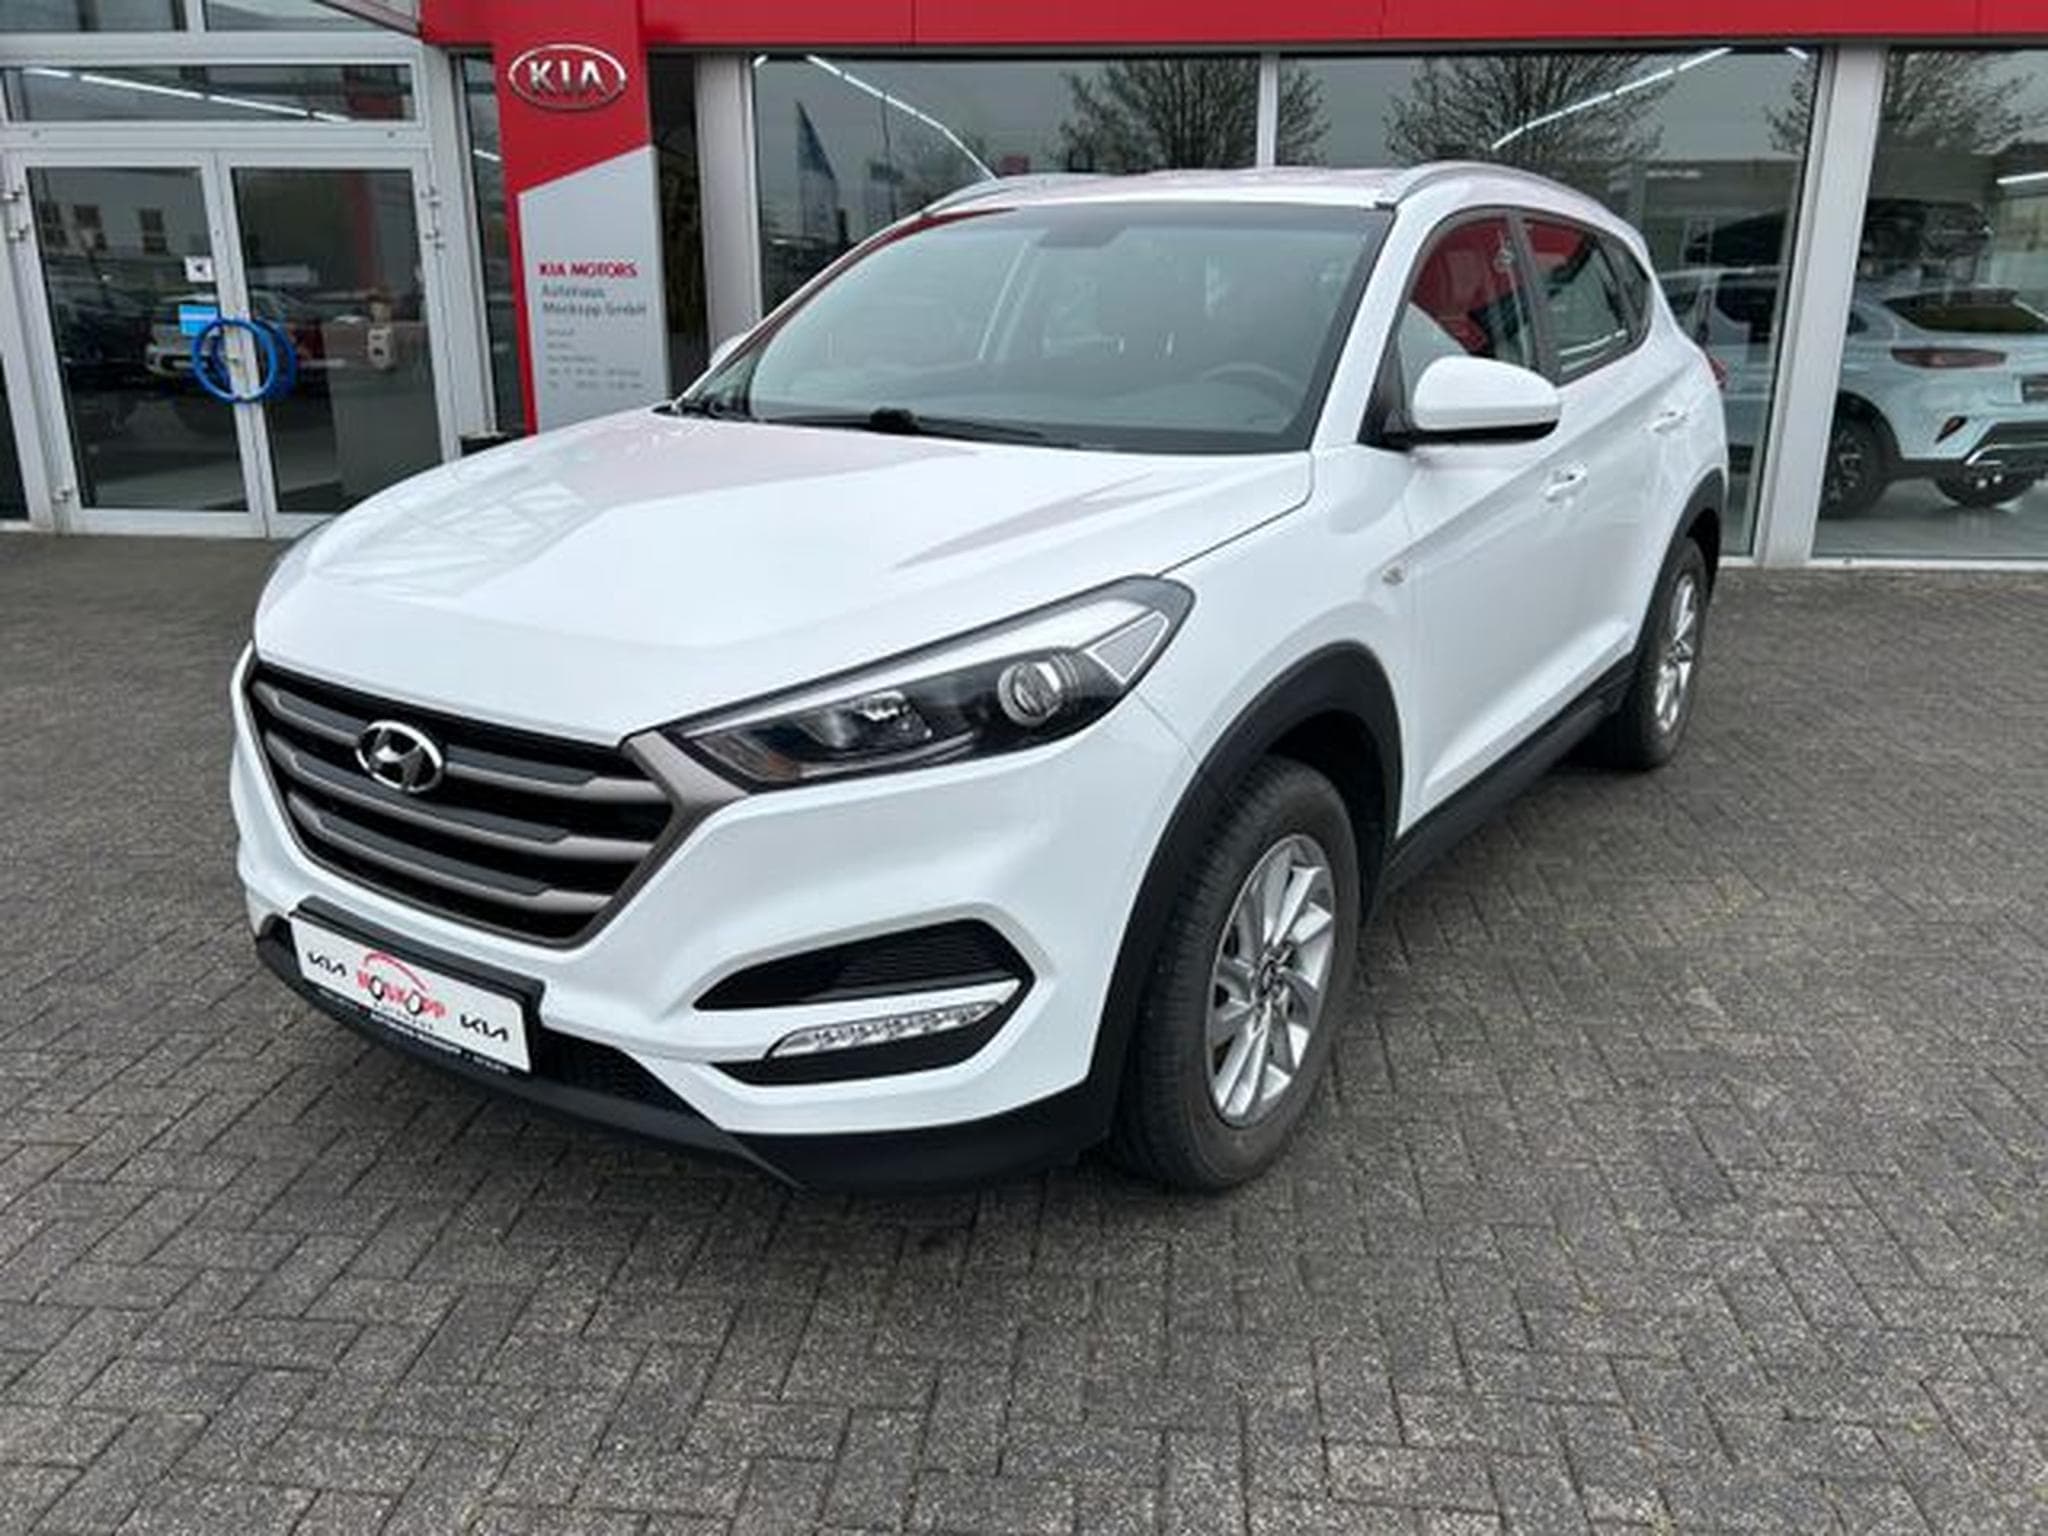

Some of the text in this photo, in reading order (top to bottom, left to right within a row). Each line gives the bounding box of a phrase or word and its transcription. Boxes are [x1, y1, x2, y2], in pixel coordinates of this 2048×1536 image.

[527, 59, 609, 95] KIA
[539, 262, 638, 278] KIA MOTORS
[460, 1013, 510, 1042] KIA
